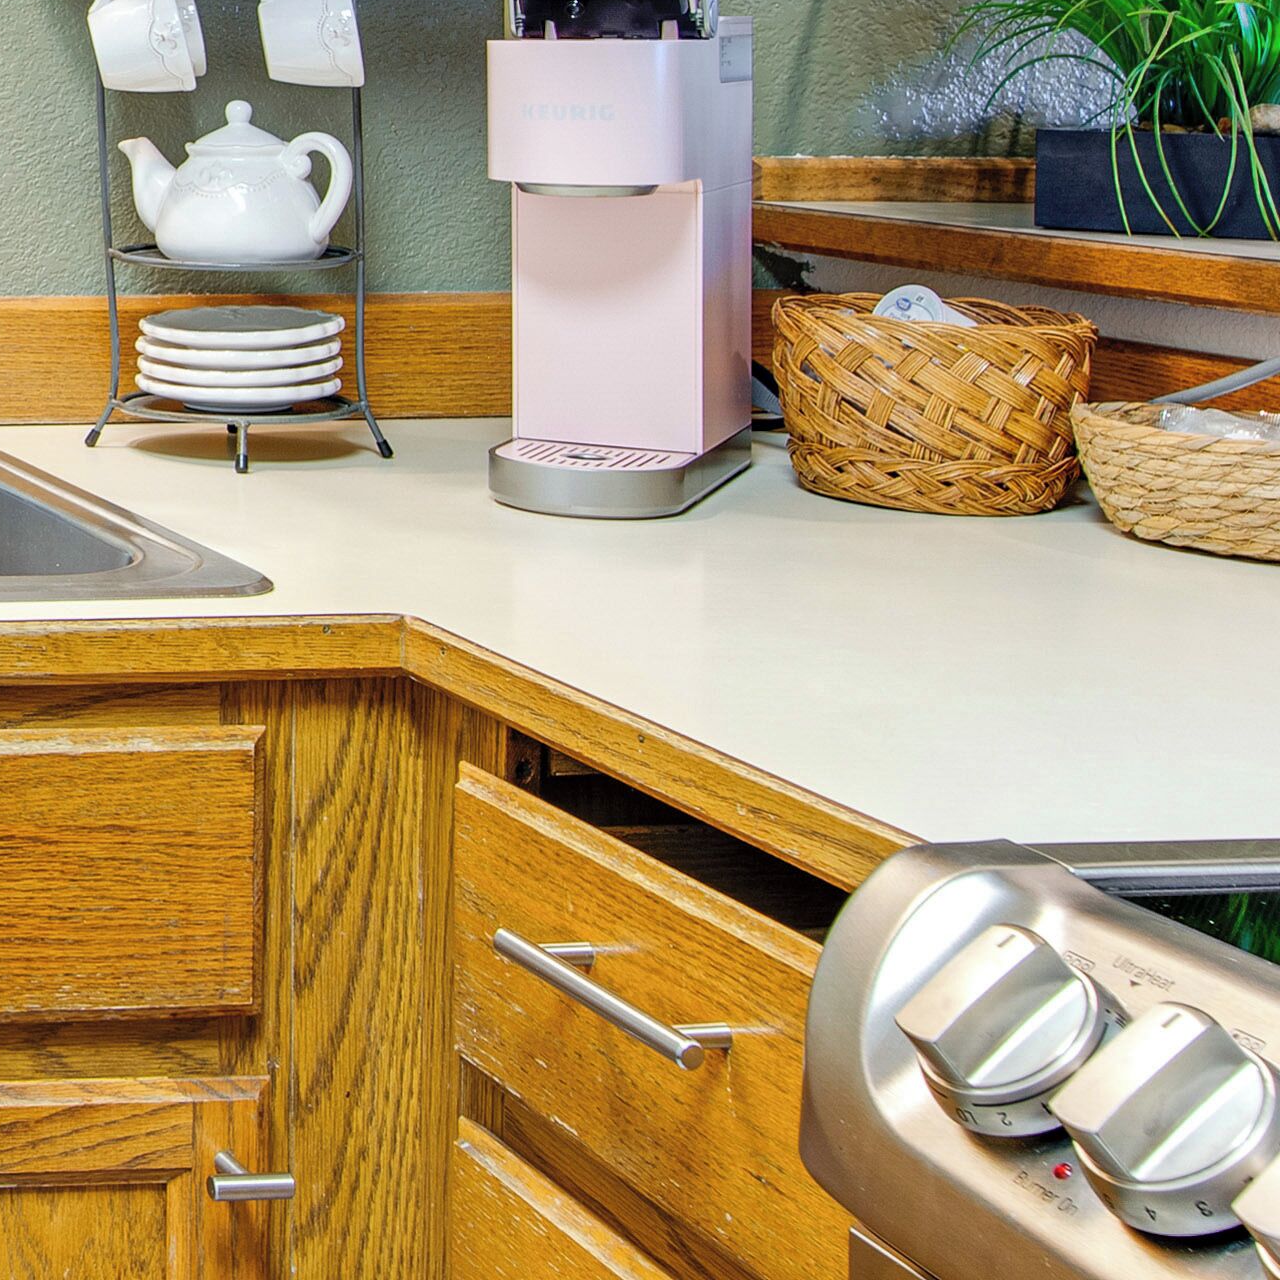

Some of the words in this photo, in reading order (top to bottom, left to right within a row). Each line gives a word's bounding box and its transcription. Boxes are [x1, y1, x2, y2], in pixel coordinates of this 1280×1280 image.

[520, 102, 615, 121] KEURIG
[1112, 955, 1176, 992] UltraHeat
[1013, 1170, 1060, 1203] Burner
[1057, 1197, 1079, 1216] On
